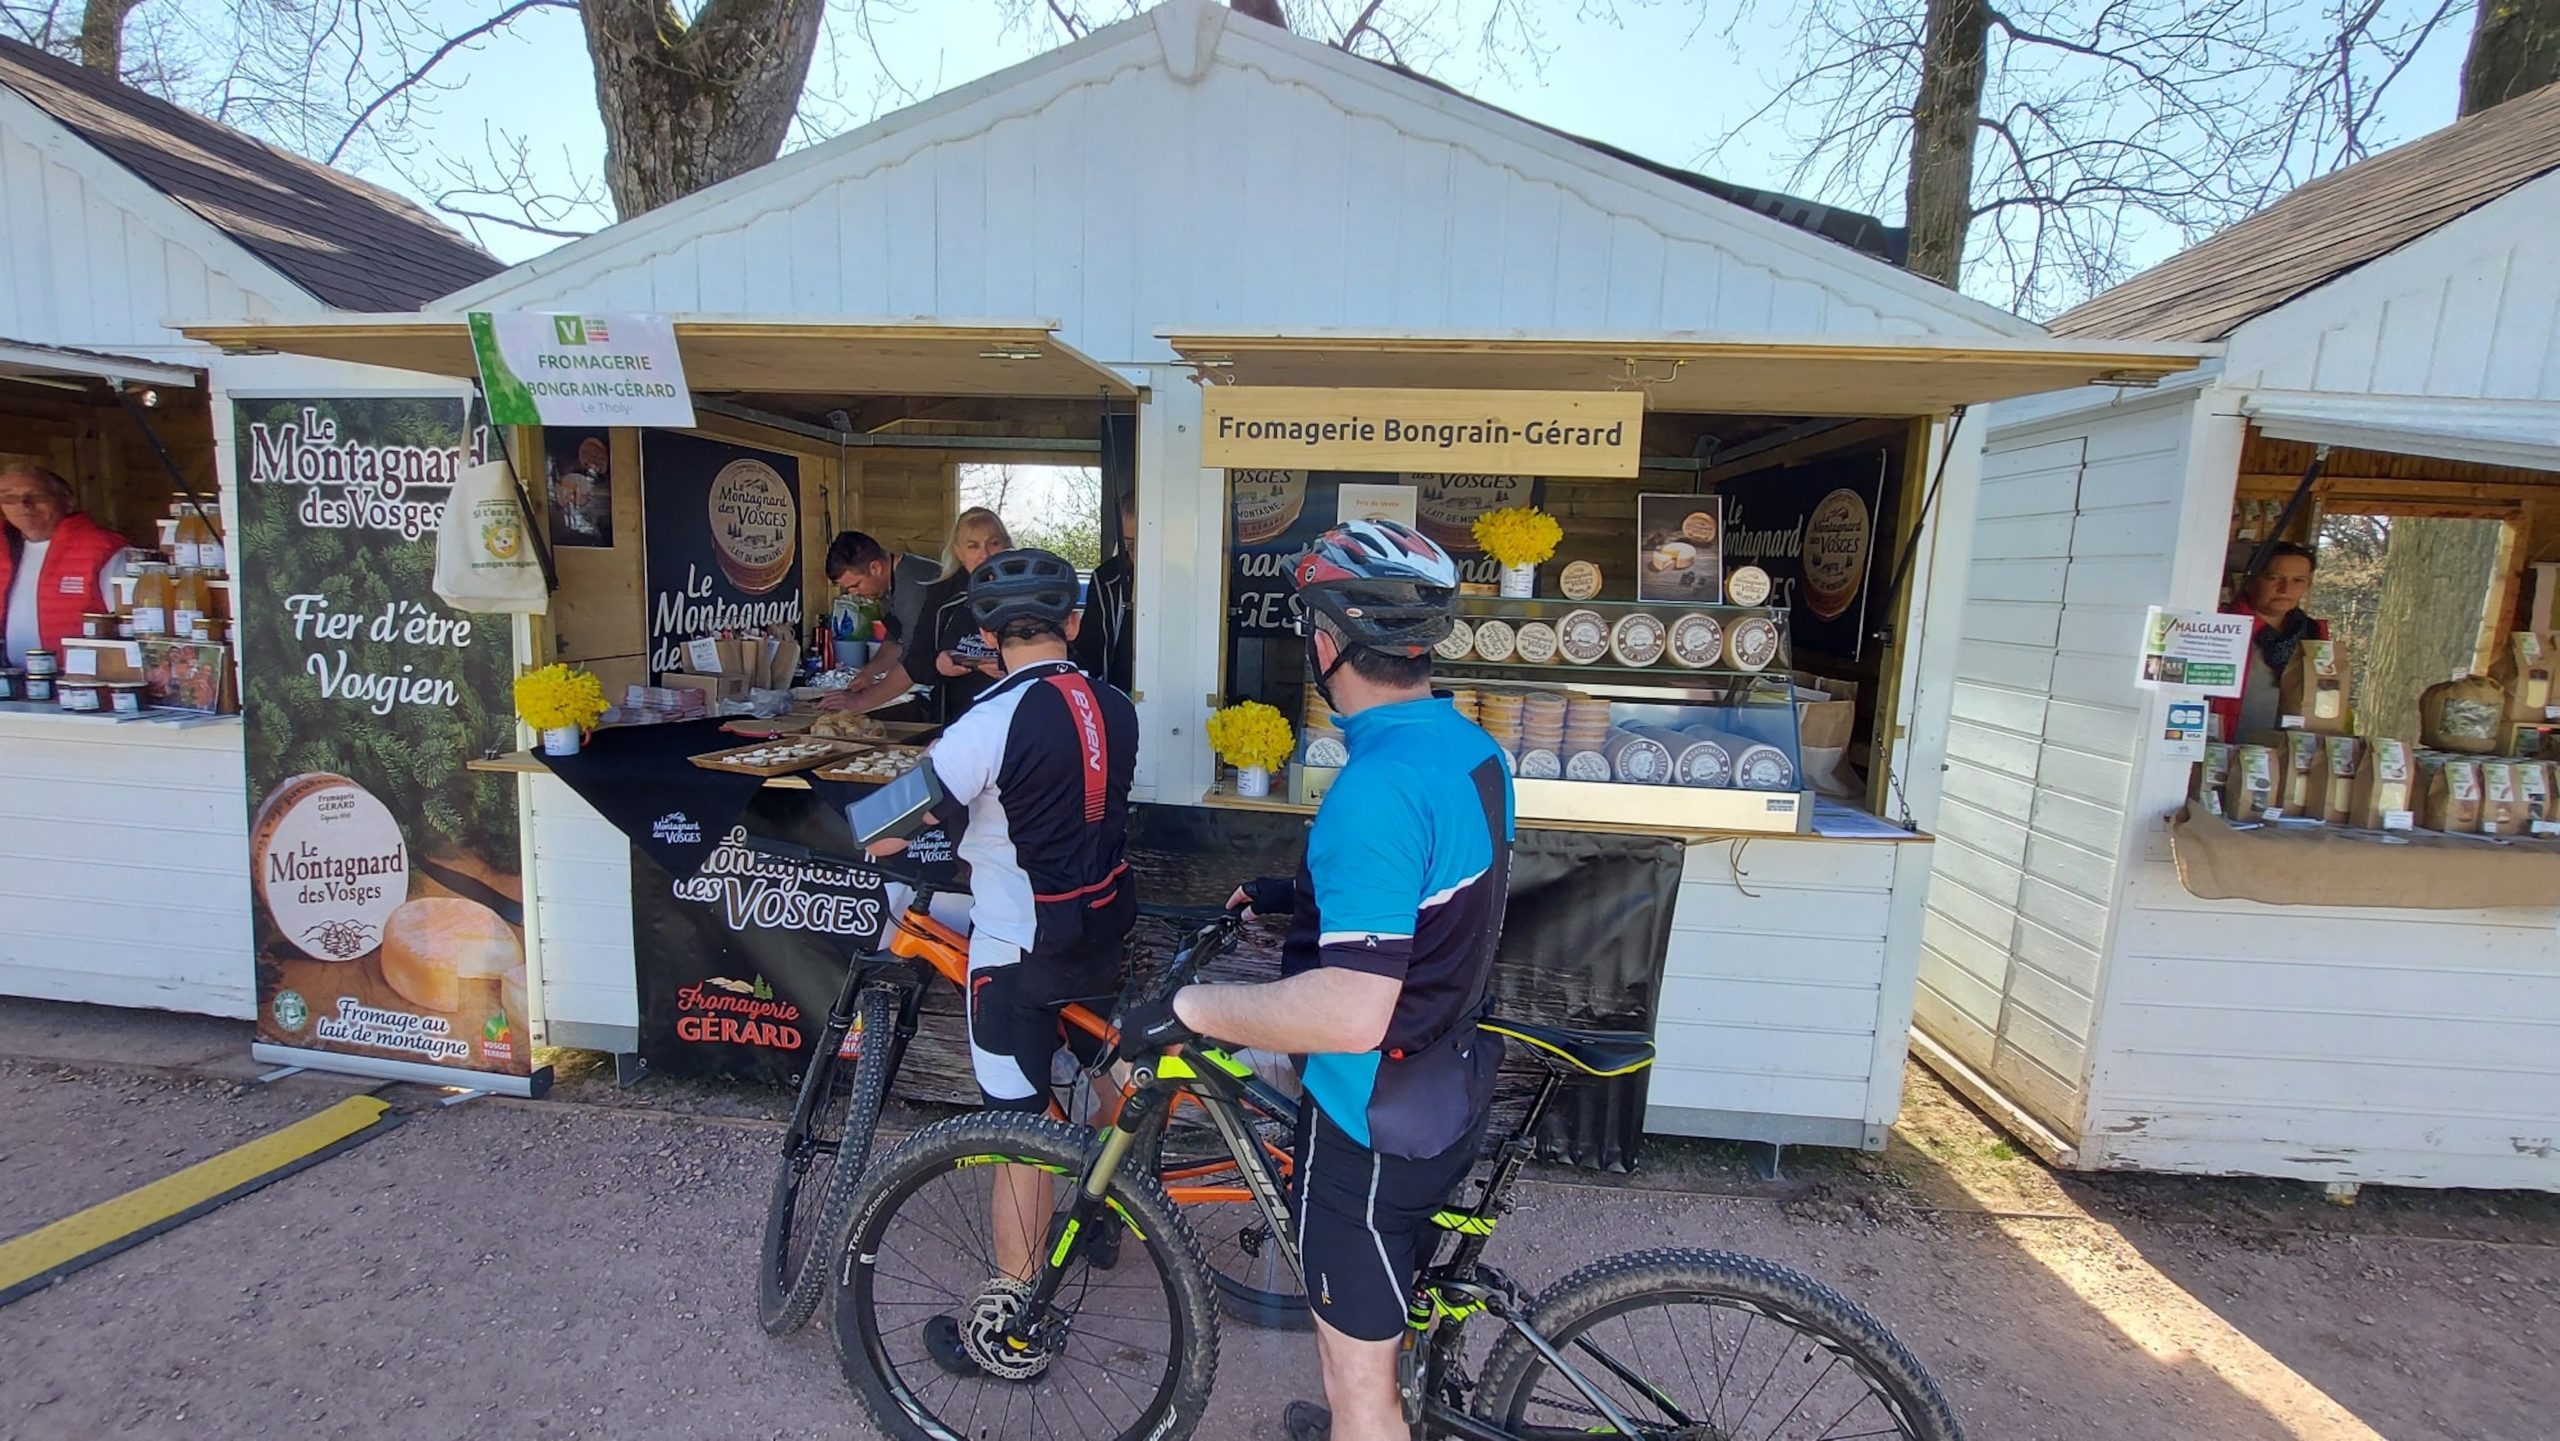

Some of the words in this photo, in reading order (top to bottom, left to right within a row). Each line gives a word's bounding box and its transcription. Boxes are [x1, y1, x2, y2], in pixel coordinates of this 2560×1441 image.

[538, 354, 653, 370] FROMAGERIE
[527, 379, 676, 398] BONGRAIN-GÉRARD
[305, 409, 335, 441] Le
[1219, 416, 1375, 446] Fromagerie
[1384, 418, 1623, 448] Bongrain-Gérard
[252, 425, 488, 501] Montagnard
[733, 480, 744, 492] Le
[1439, 473, 1519, 489] VOSGES
[303, 489, 347, 524] des
[347, 488, 445, 538] Vosges
[719, 485, 787, 511] Montagnard
[1728, 494, 1743, 526] Le
[718, 503, 735, 514] des
[737, 505, 787, 527] VOSGES
[1722, 513, 1803, 565] ontagnard
[1820, 535, 1860, 554] VOSGES
[687, 563, 713, 598] Le
[284, 593, 363, 641] Fier
[370, 600, 471, 647] d'être
[2175, 622, 2241, 635] MALGLAIVE
[652, 636, 683, 673] de
[306, 650, 459, 715] Vosgien
[301, 841, 318, 858] Le
[665, 831, 702, 844] VOSGES
[270, 844, 404, 885] Montagnard
[298, 885, 325, 904] des
[324, 881, 381, 906] Vosges
[724, 876, 881, 937] VOSGES
[338, 999, 418, 1031] Fromage
[421, 1018, 448, 1033] au
[678, 981, 800, 1020] Fromagerie
[319, 1018, 351, 1039] lait
[351, 1026, 373, 1043] de
[375, 1032, 467, 1058] montagne
[677, 1011, 802, 1049] GÉRARD
